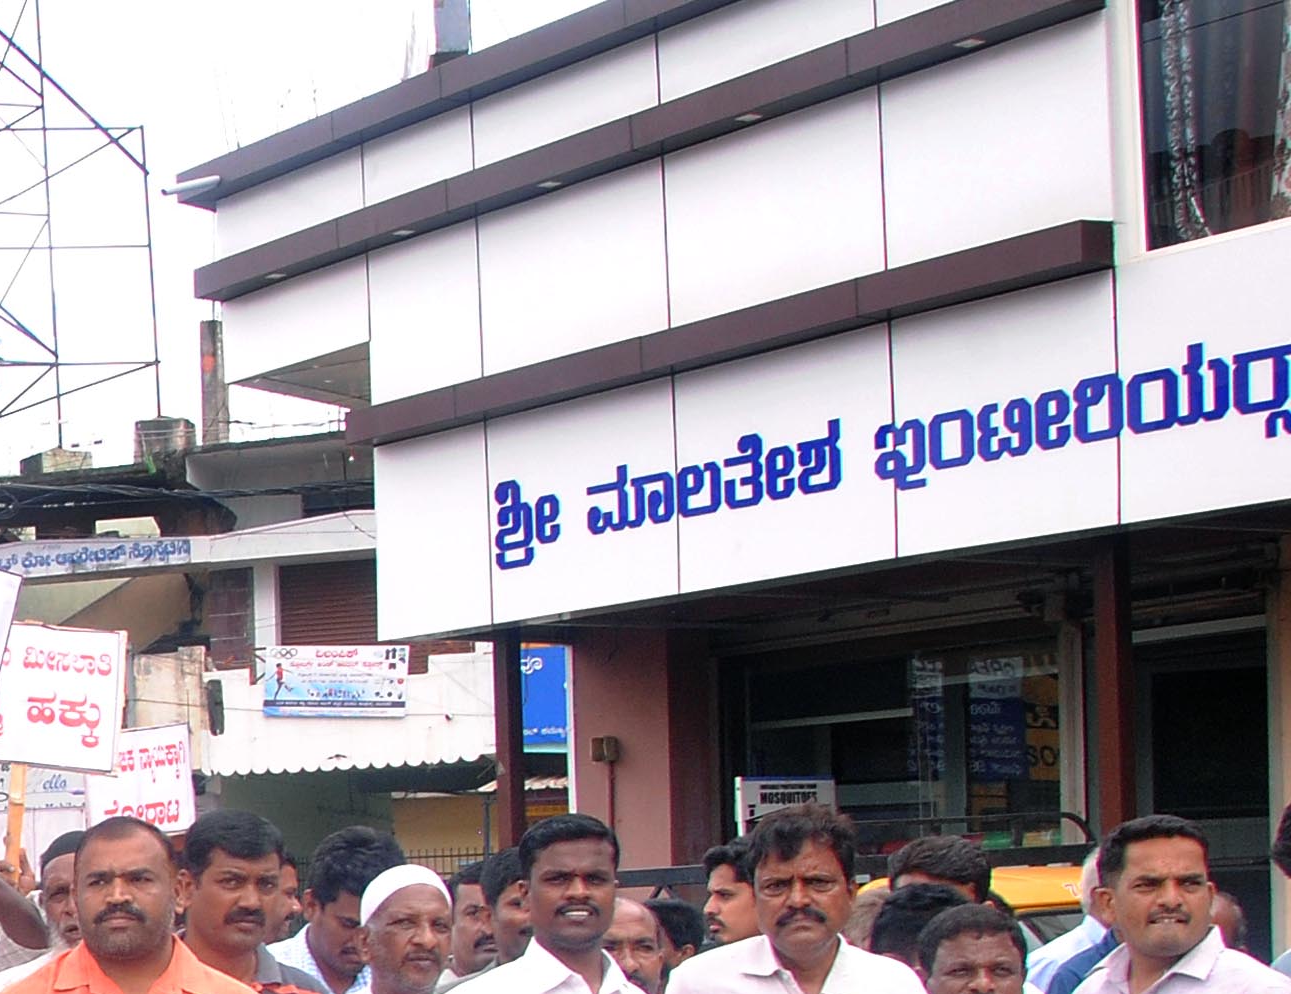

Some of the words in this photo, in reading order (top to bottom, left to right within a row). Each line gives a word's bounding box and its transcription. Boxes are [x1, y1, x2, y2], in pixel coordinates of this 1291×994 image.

[494, 479, 561, 569] ಶ್ರೀ
[587, 419, 842, 536] ಮಾಲತೇಶ
[23, 646, 112, 676] ಮೀಸಲಾತಿ
[27, 693, 101, 748] ಹಕ್ಕು
